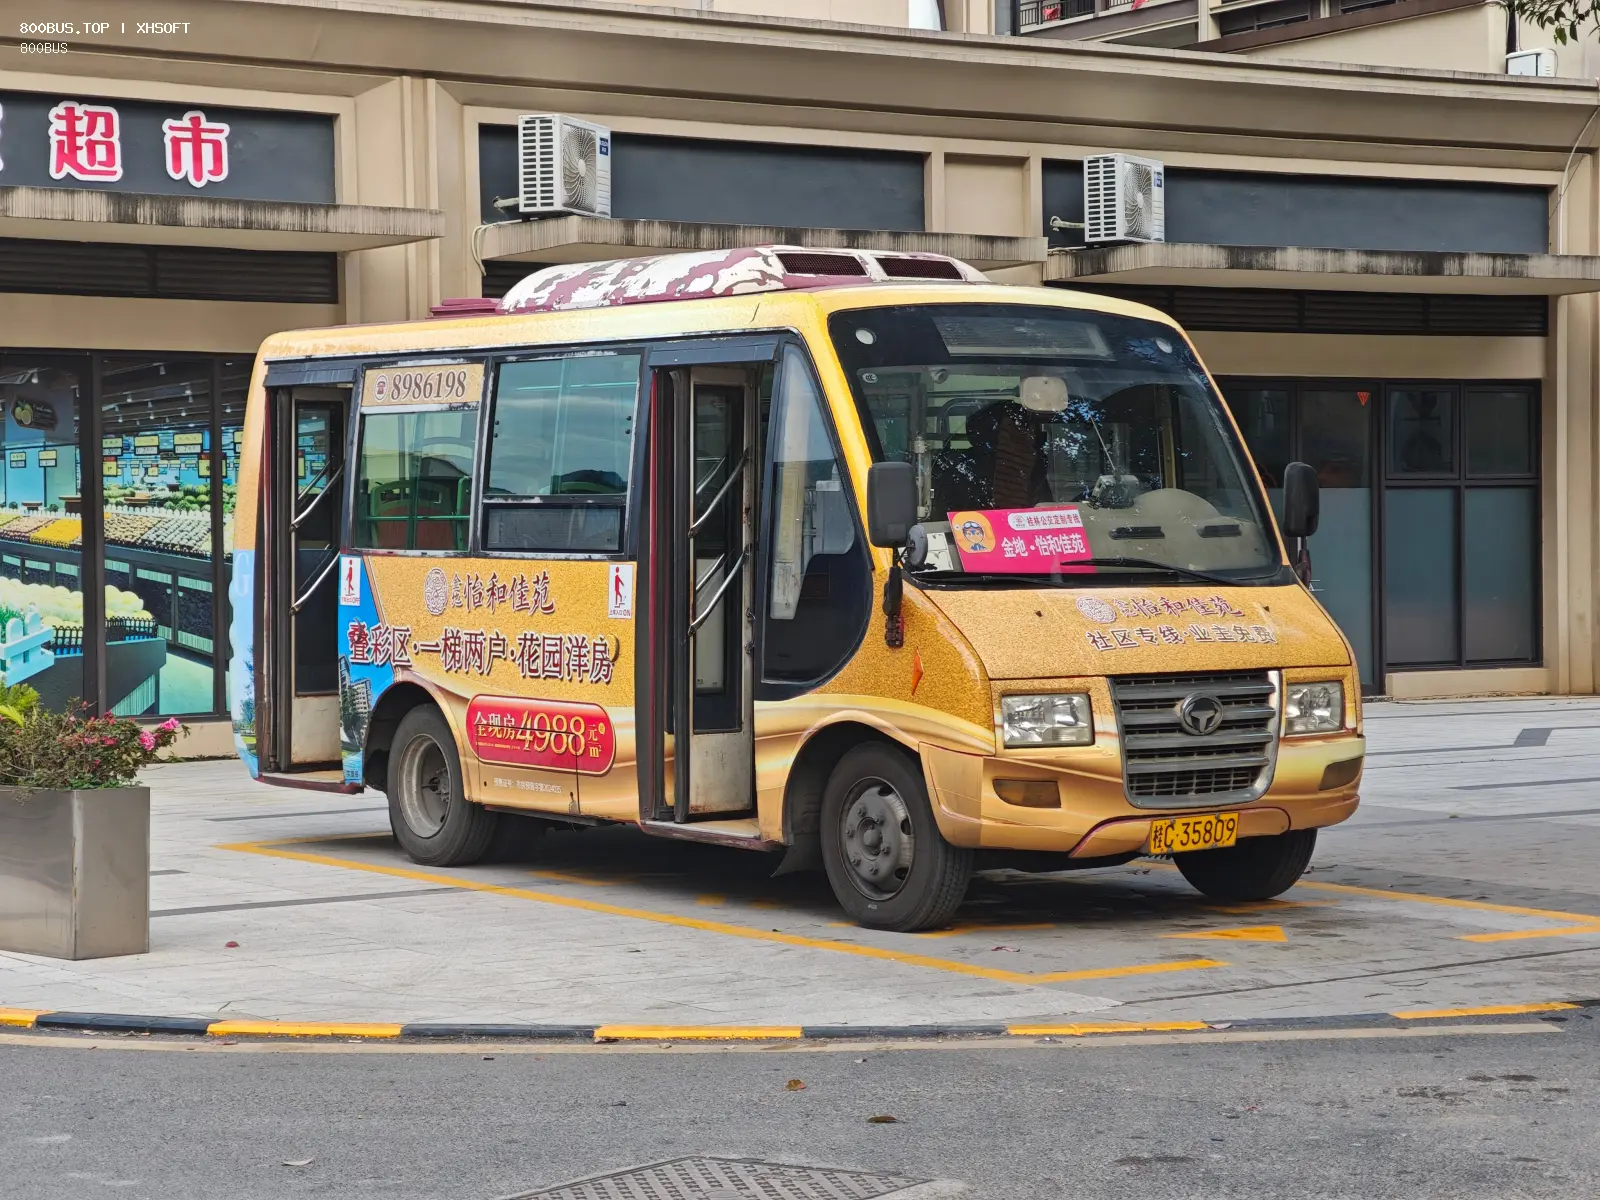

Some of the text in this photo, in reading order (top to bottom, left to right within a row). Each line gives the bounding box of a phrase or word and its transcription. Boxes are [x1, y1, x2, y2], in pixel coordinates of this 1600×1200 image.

[0, 100, 229, 188] 超市
[391, 371, 467, 400] 8986198
[1026, 513, 1081, 528] 桂林公交定制专线
[516, 709, 586, 756] 4988
